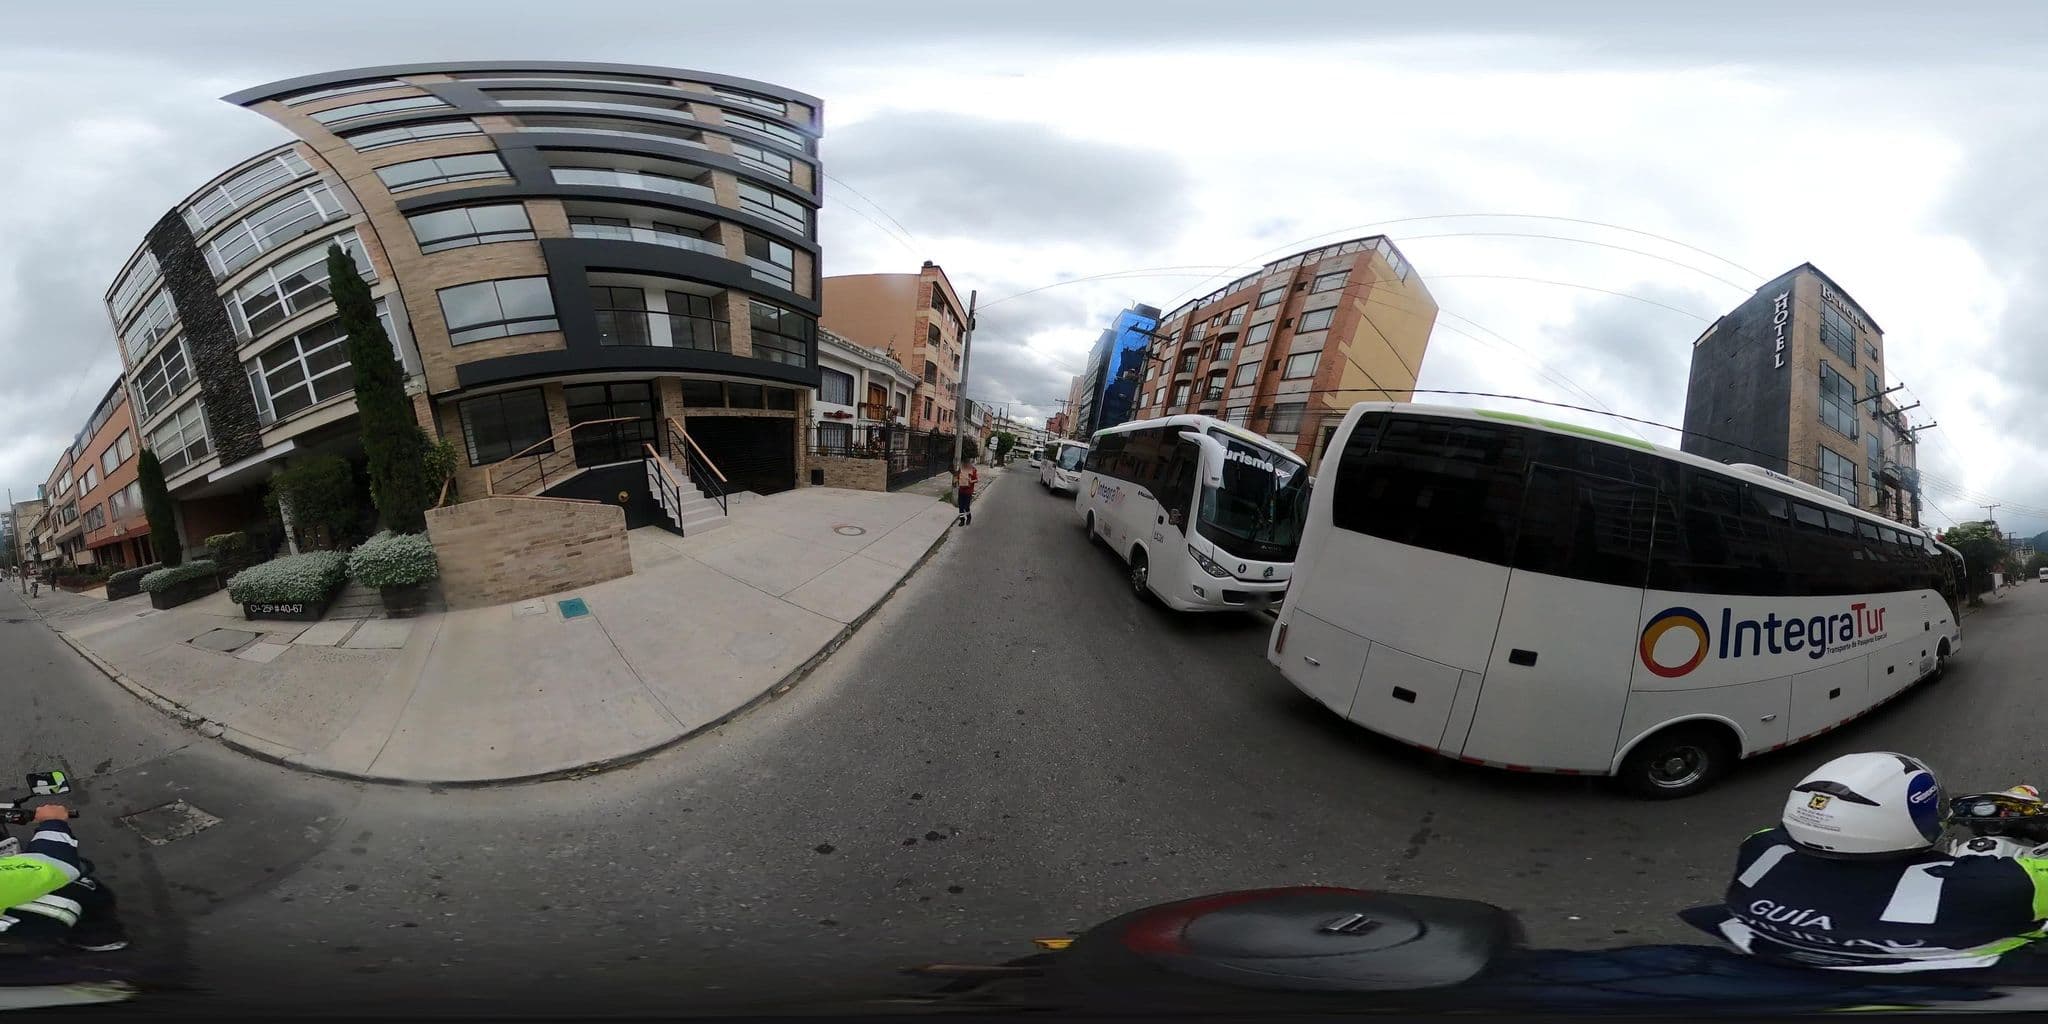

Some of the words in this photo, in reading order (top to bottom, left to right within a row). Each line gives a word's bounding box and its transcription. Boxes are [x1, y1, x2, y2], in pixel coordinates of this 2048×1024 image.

[1773, 297, 1788, 369] HOTEL
[1222, 448, 1274, 473] urismo
[280, 604, 302, 613] 40-67
[1718, 602, 1886, 660] IntegraTur
[1750, 899, 1832, 930] GUÍA
